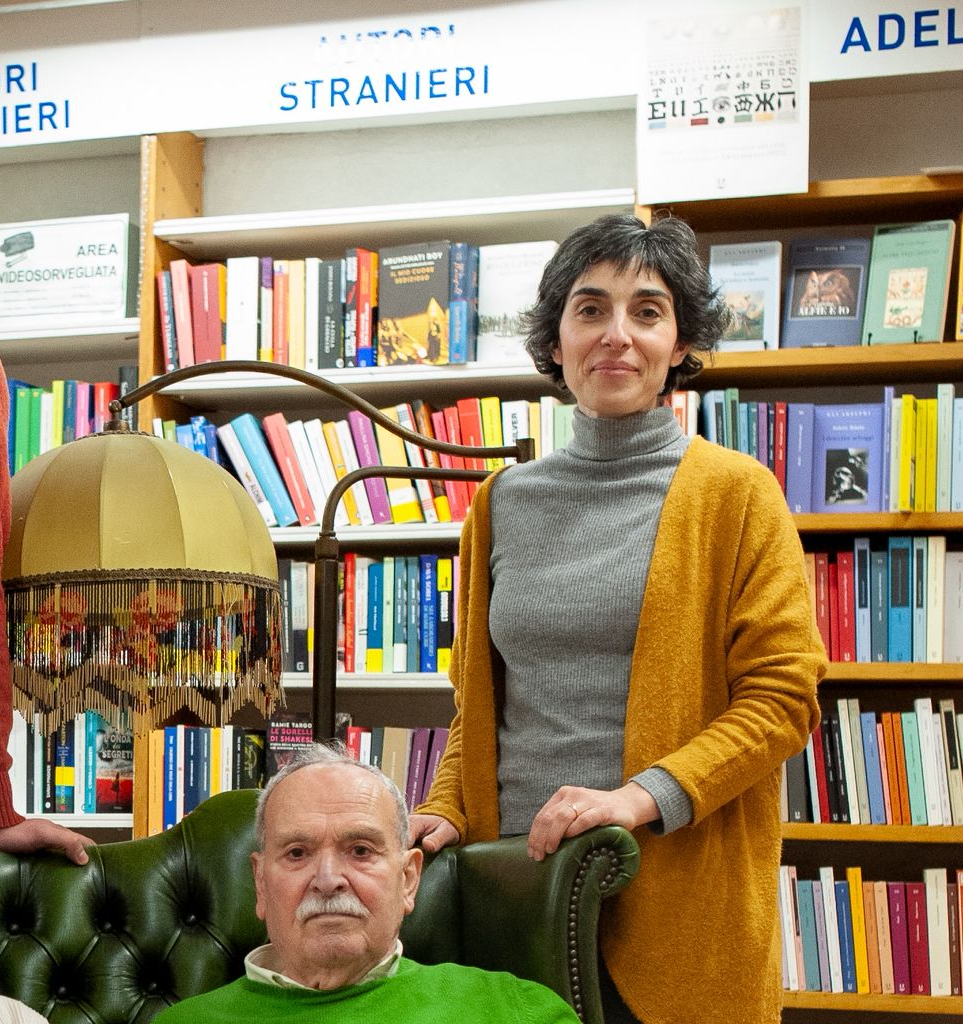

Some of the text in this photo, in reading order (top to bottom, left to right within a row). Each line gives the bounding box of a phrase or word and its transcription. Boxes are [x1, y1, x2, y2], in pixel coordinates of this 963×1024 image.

[840, 8, 963, 54] ADEL
[279, 64, 489, 111] STRANIERI
[76, 243, 118, 257] AREA
[102, 750, 133, 759] SEGRETI
